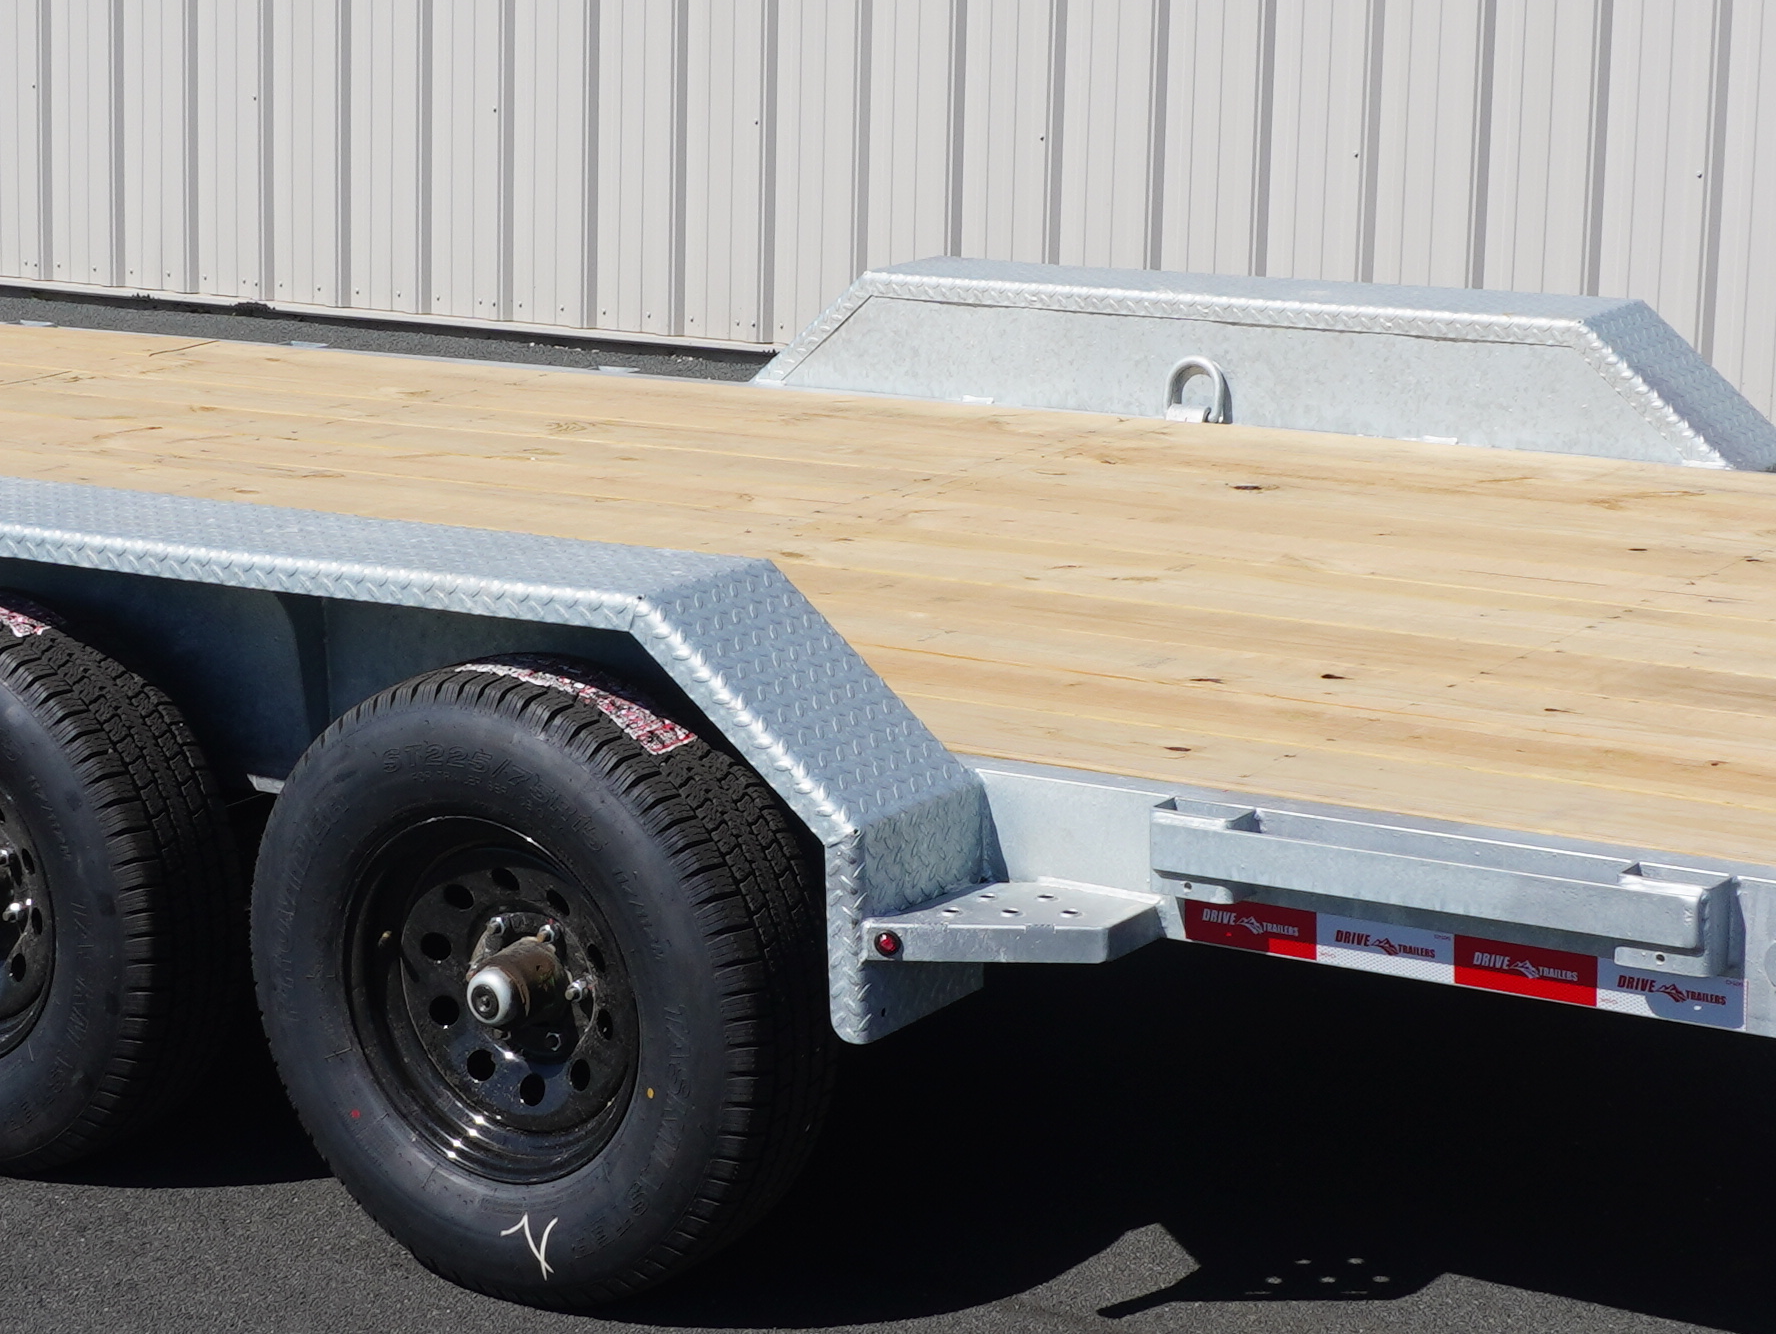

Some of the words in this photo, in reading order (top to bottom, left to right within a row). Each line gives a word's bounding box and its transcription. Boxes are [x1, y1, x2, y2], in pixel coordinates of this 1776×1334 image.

[1202, 908, 1236, 926] DRIVE
[1261, 921, 1299, 937] TRAILERS
[1335, 929, 1371, 947] DRIVE
[1397, 943, 1436, 959] TRAILERS
[1473, 951, 1510, 970] DRIVE
[1538, 965, 1579, 982] TRAILERS
[1617, 974, 1657, 993] DRIVE
[1685, 989, 1727, 1006] TRAILERS
